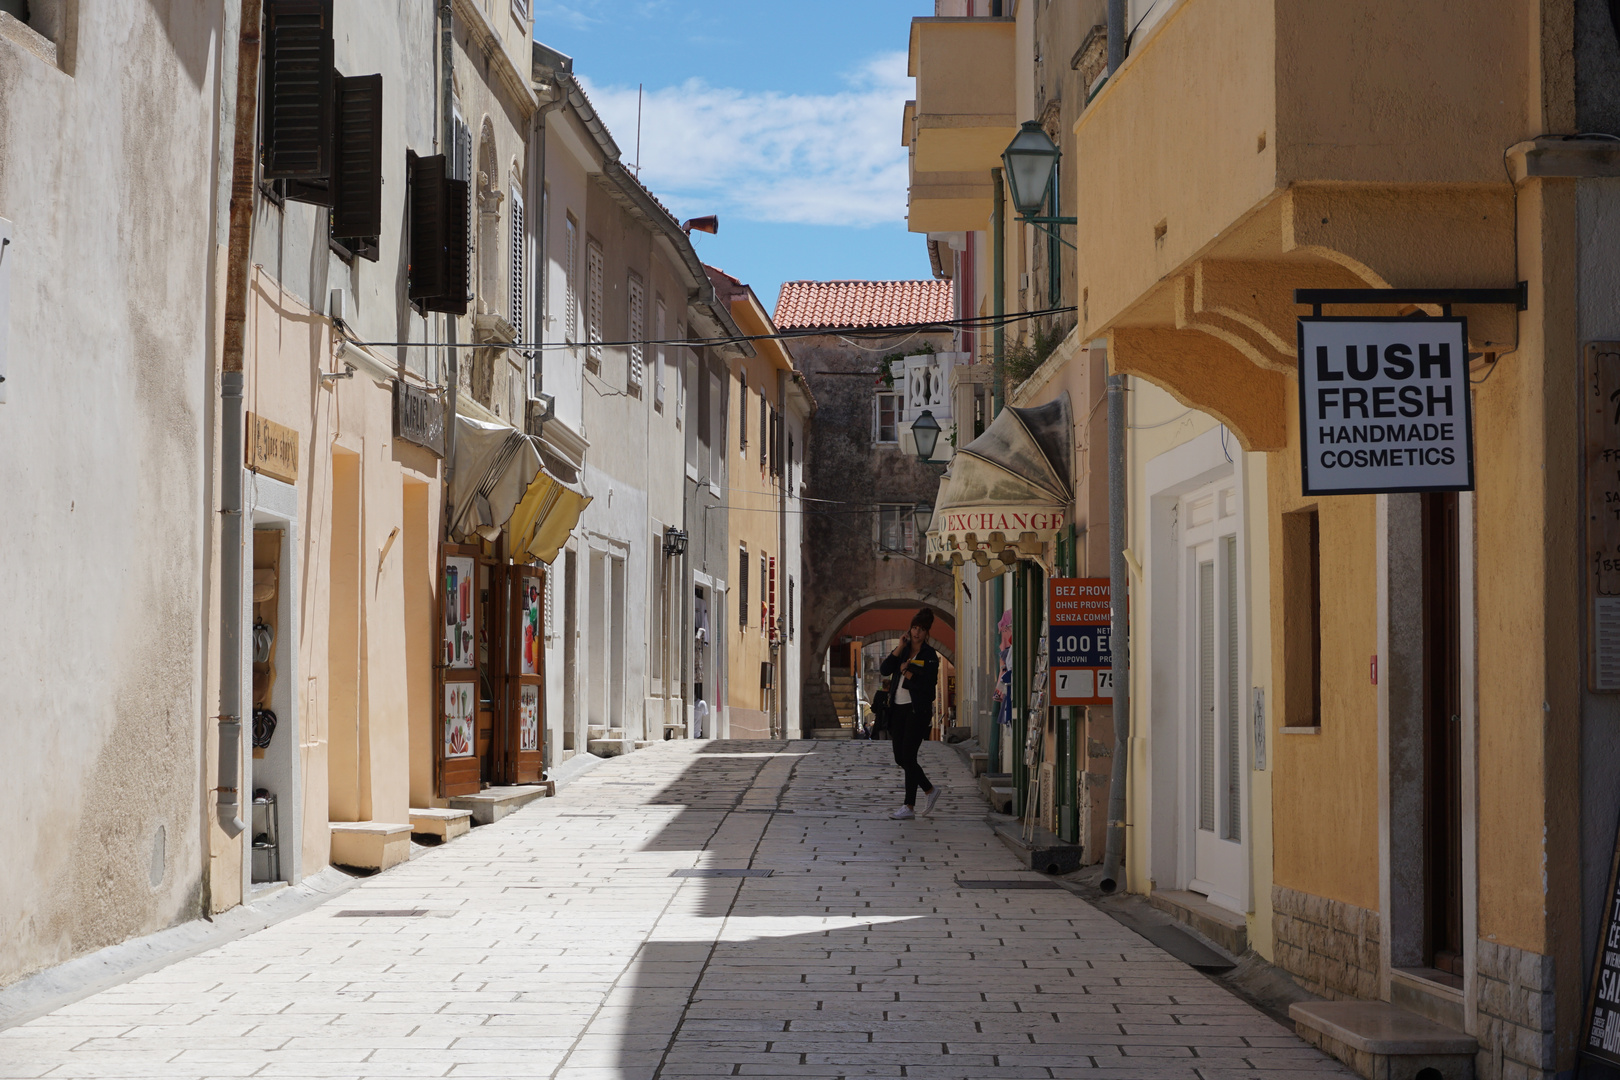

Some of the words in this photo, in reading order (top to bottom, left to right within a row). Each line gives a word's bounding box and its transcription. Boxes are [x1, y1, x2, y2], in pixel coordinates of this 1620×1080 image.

[1316, 342, 1452, 382] LUSH
[1317, 385, 1454, 420] FRESH
[1319, 423, 1455, 444] HANDMADE
[1320, 447, 1456, 469] COSMETICS
[948, 513, 1065, 532] EXCHANGE
[1056, 586, 1076, 596] BEZ
[1079, 586, 1111, 596] PROVI
[1056, 601, 1078, 609] OHNE
[1056, 613, 1082, 621] SENZA
[1083, 613, 1110, 621] COMMI
[1057, 636, 1091, 652] 100
[1059, 675, 1068, 689] 7
